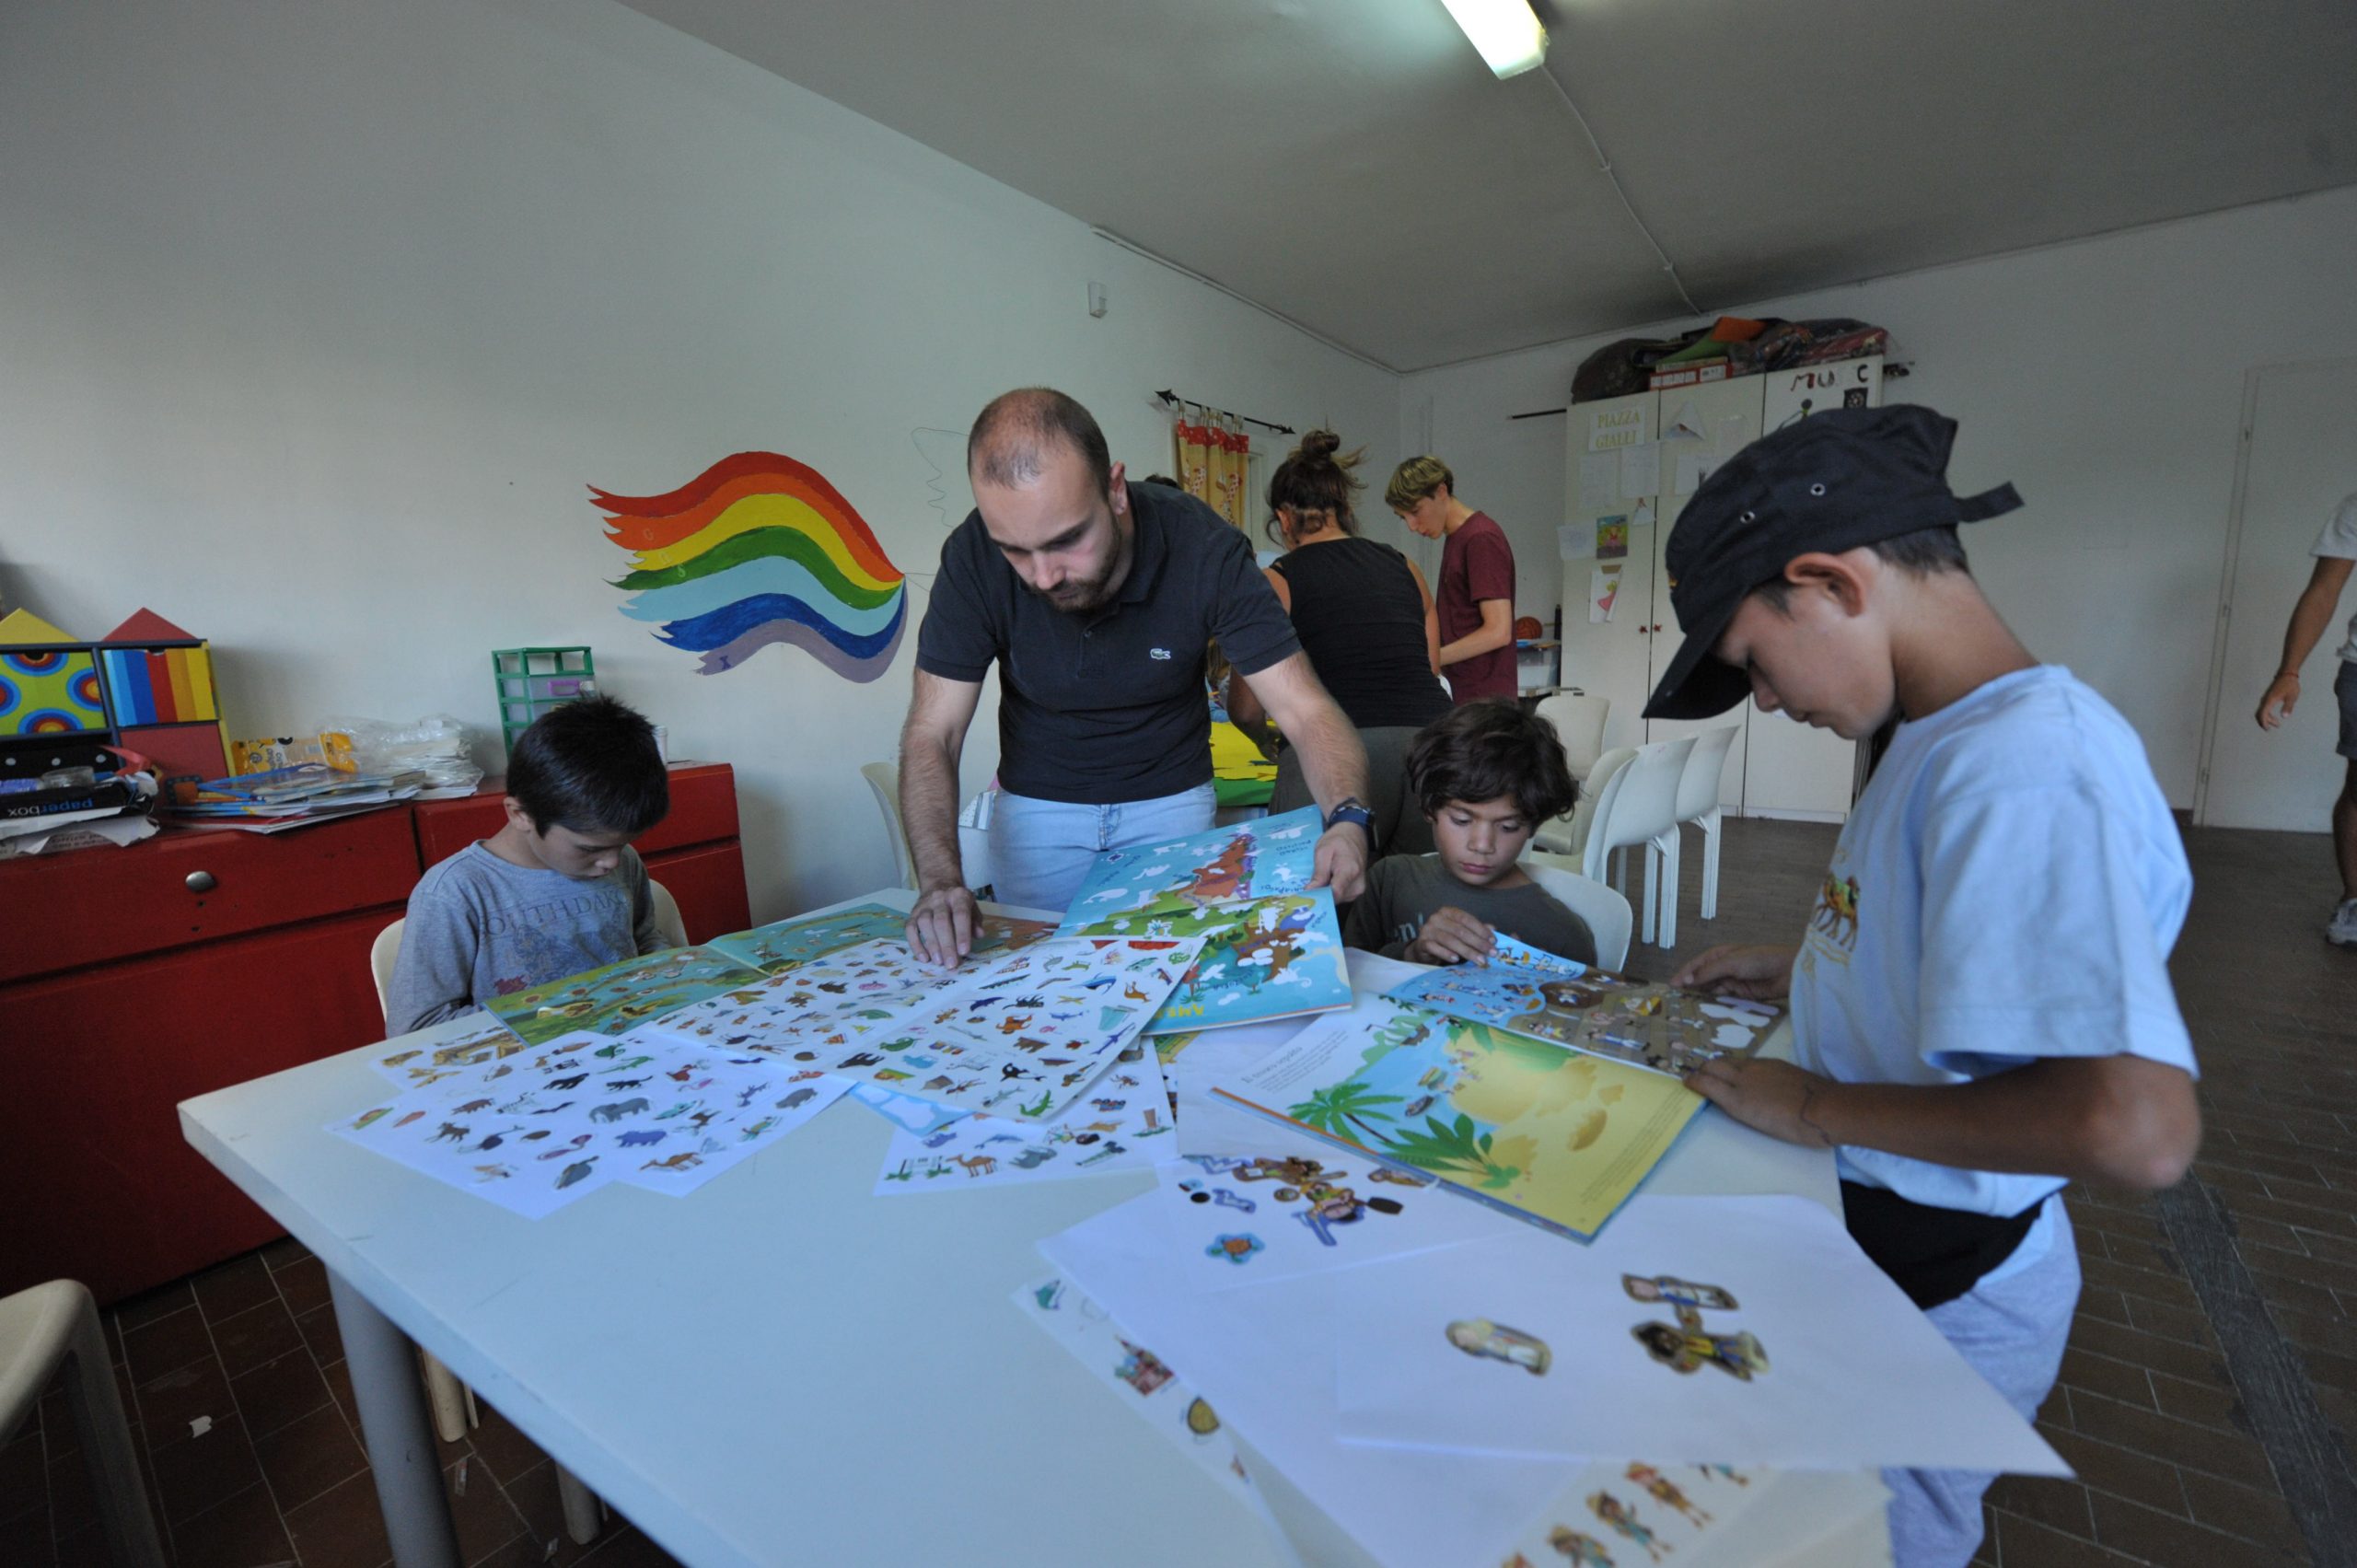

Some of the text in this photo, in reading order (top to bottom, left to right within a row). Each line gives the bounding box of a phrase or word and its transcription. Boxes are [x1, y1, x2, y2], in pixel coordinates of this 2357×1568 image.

[1596, 410, 1642, 429] PIAZZA
[1595, 431, 1638, 449] GIALLI
[7, 797, 94, 818] paperbox
[484, 889, 628, 935] OUTH DAKO
